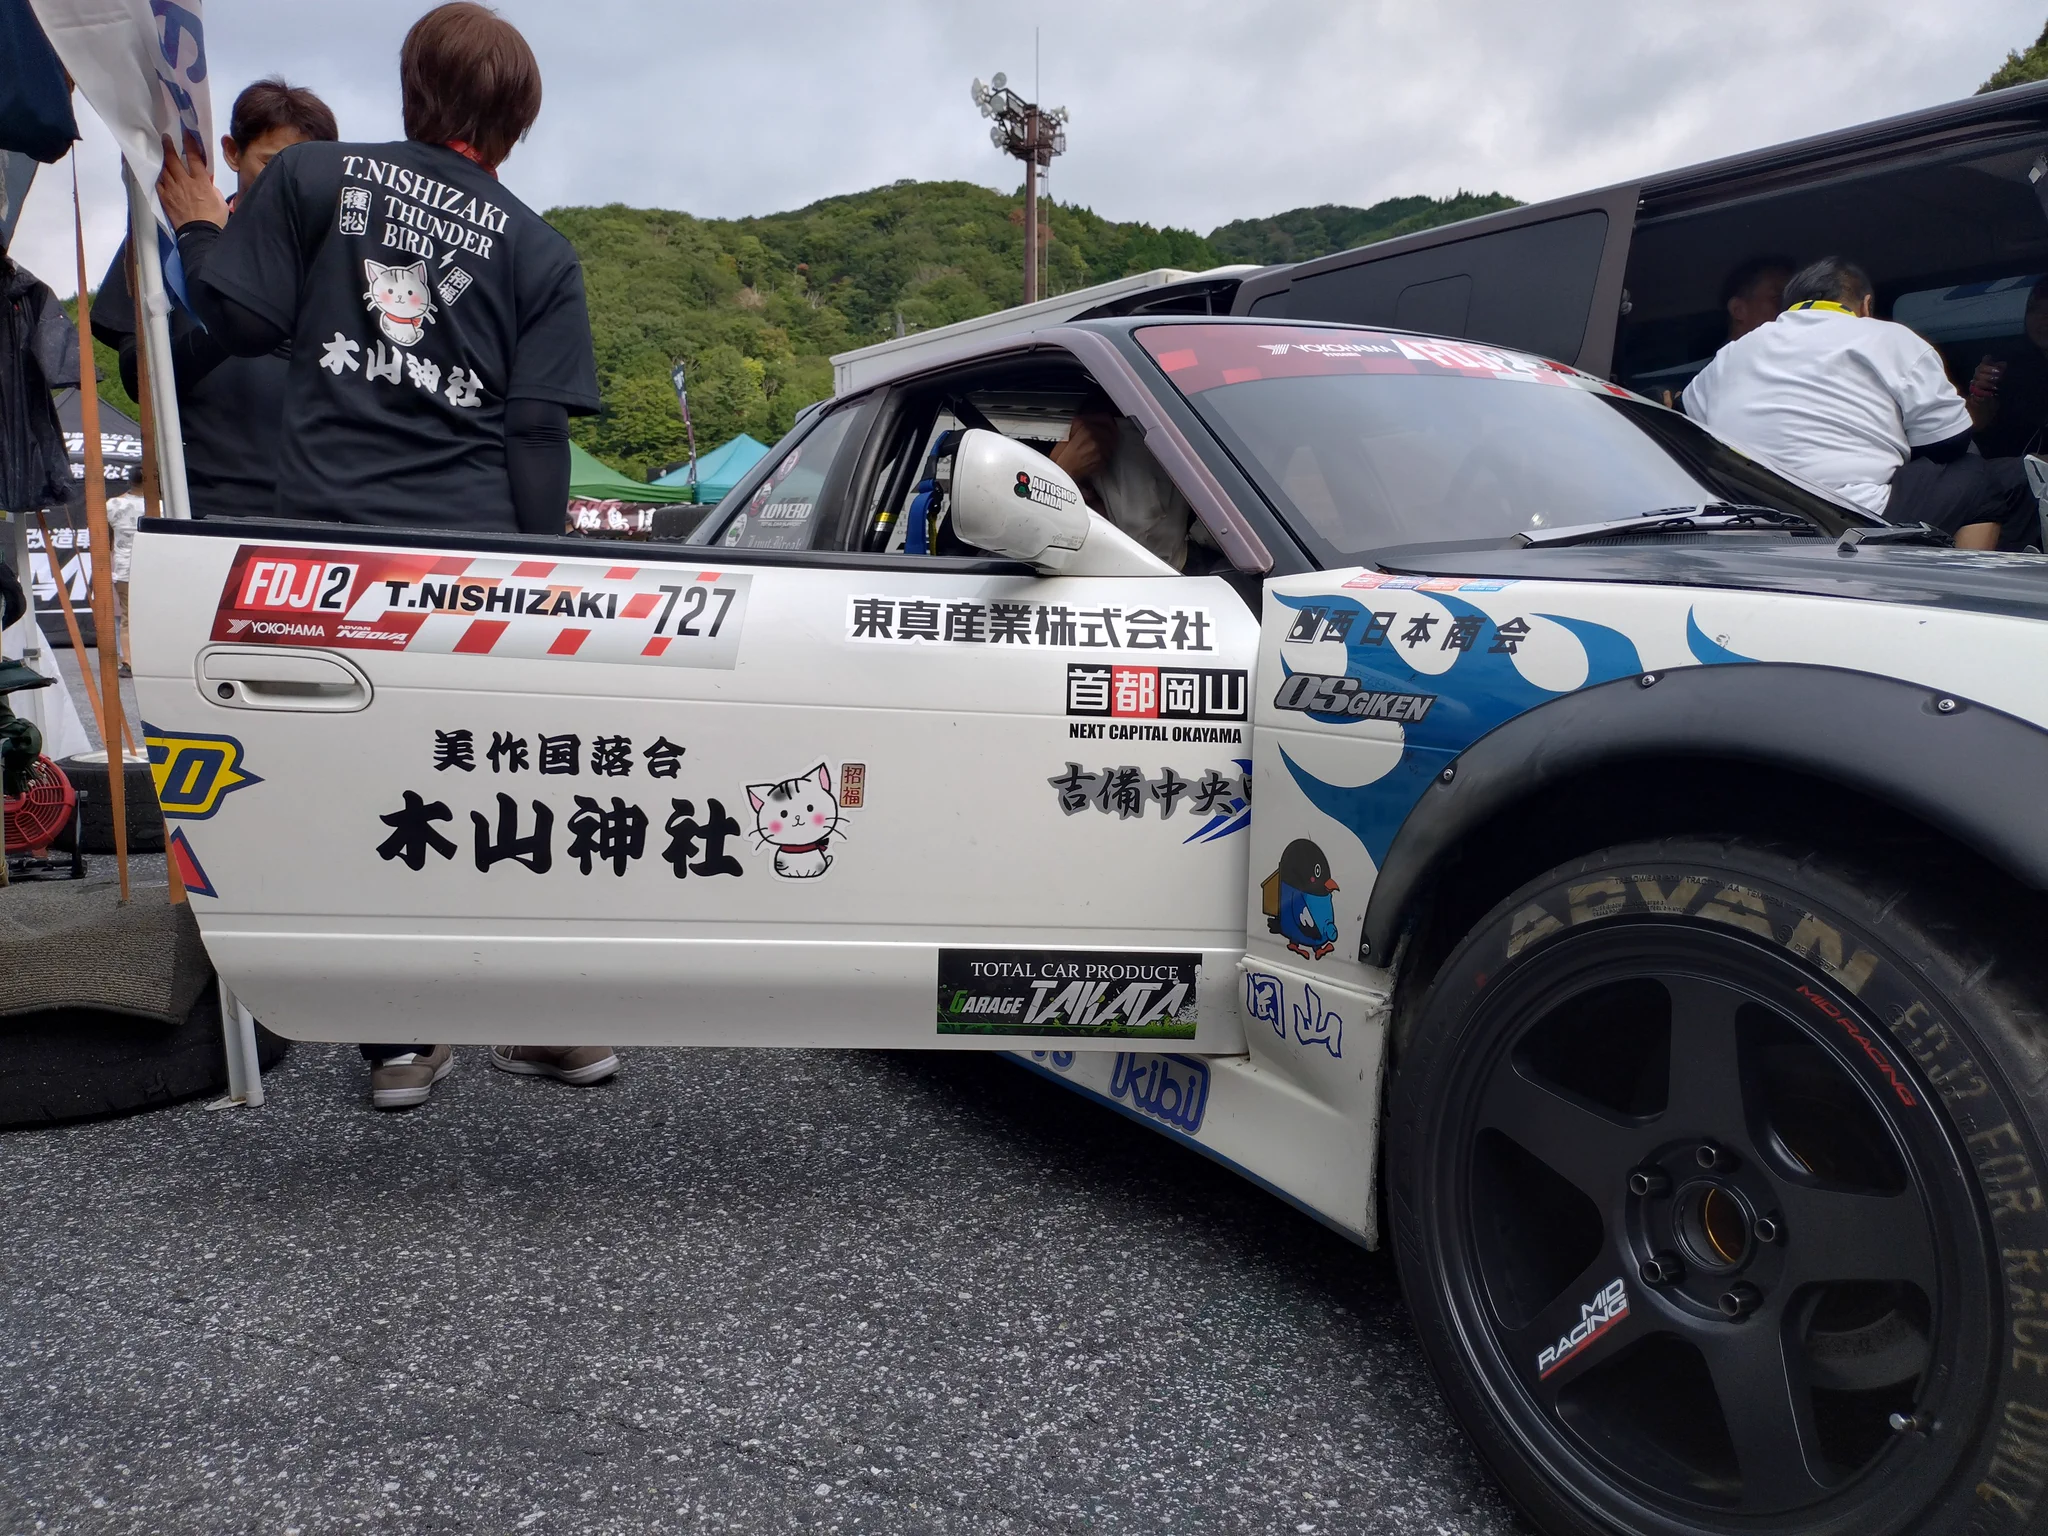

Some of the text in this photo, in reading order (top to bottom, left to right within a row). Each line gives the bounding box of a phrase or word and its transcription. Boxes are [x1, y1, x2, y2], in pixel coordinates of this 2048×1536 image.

[343, 156, 510, 234] T.NISHIZAKI
[381, 222, 434, 260] BIRD
[384, 195, 493, 259] THUNDER
[319, 332, 484, 408] 木山神社
[1031, 489, 1062, 510] KANDA
[1033, 477, 1077, 503] AUTOSHOP
[244, 562, 350, 609] FDJ2
[385, 580, 618, 619] T.NISHIZAKI
[251, 621, 325, 638] YOKOHAMA
[653, 585, 736, 637] 727
[852, 598, 1214, 652] 東真産業株式会社
[1320, 609, 1532, 655] 西日本商会
[1068, 668, 1245, 716] 首都岡山
[1276, 674, 1437, 721] OS GIKEN
[433, 728, 686, 779] 美作国落合
[1069, 723, 1242, 744] NEXT CAPITAL OKAYAMA
[843, 766, 863, 806] 招福
[376, 790, 744, 879] 木山神社
[970, 962, 1179, 981] TOTAL CAR PRODUCE
[949, 980, 1189, 1027] GARAGE TAKATA
[1796, 985, 1918, 1108] MID RACING
[1581, 1278, 1624, 1322] MID
[1538, 1293, 1628, 1372] RACING
